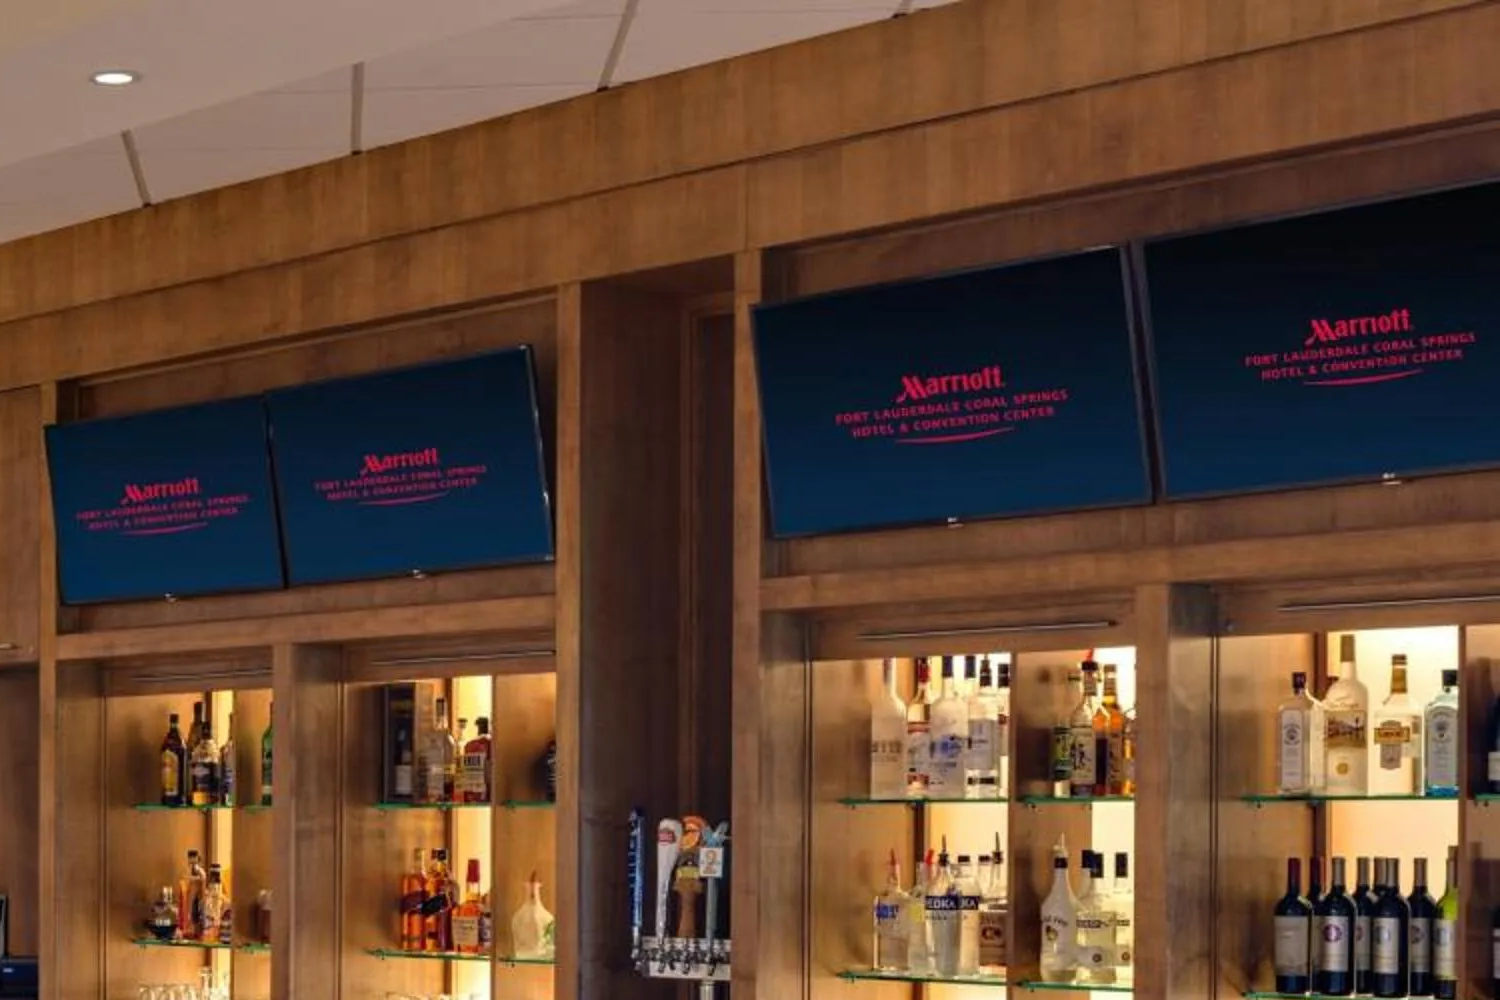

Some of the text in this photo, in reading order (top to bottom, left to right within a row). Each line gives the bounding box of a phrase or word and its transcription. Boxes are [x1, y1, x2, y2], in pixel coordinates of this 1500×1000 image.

[1305, 308, 1413, 346] Marriott
[1245, 331, 1476, 367] FORT LAUDERDALE CORAL SPRINGS
[1261, 348, 1464, 381] HOTEL & CONVENTION CENTER
[896, 364, 1007, 404] Marriott
[835, 388, 1069, 425] FORT LAUDERDALE CORAL SPRINGS
[853, 423, 895, 439] HOTEL
[913, 412, 1000, 432] CONVENTION
[1003, 405, 1056, 422] CENTER
[360, 447, 438, 475] Marriott
[120, 477, 201, 505] Marriott
